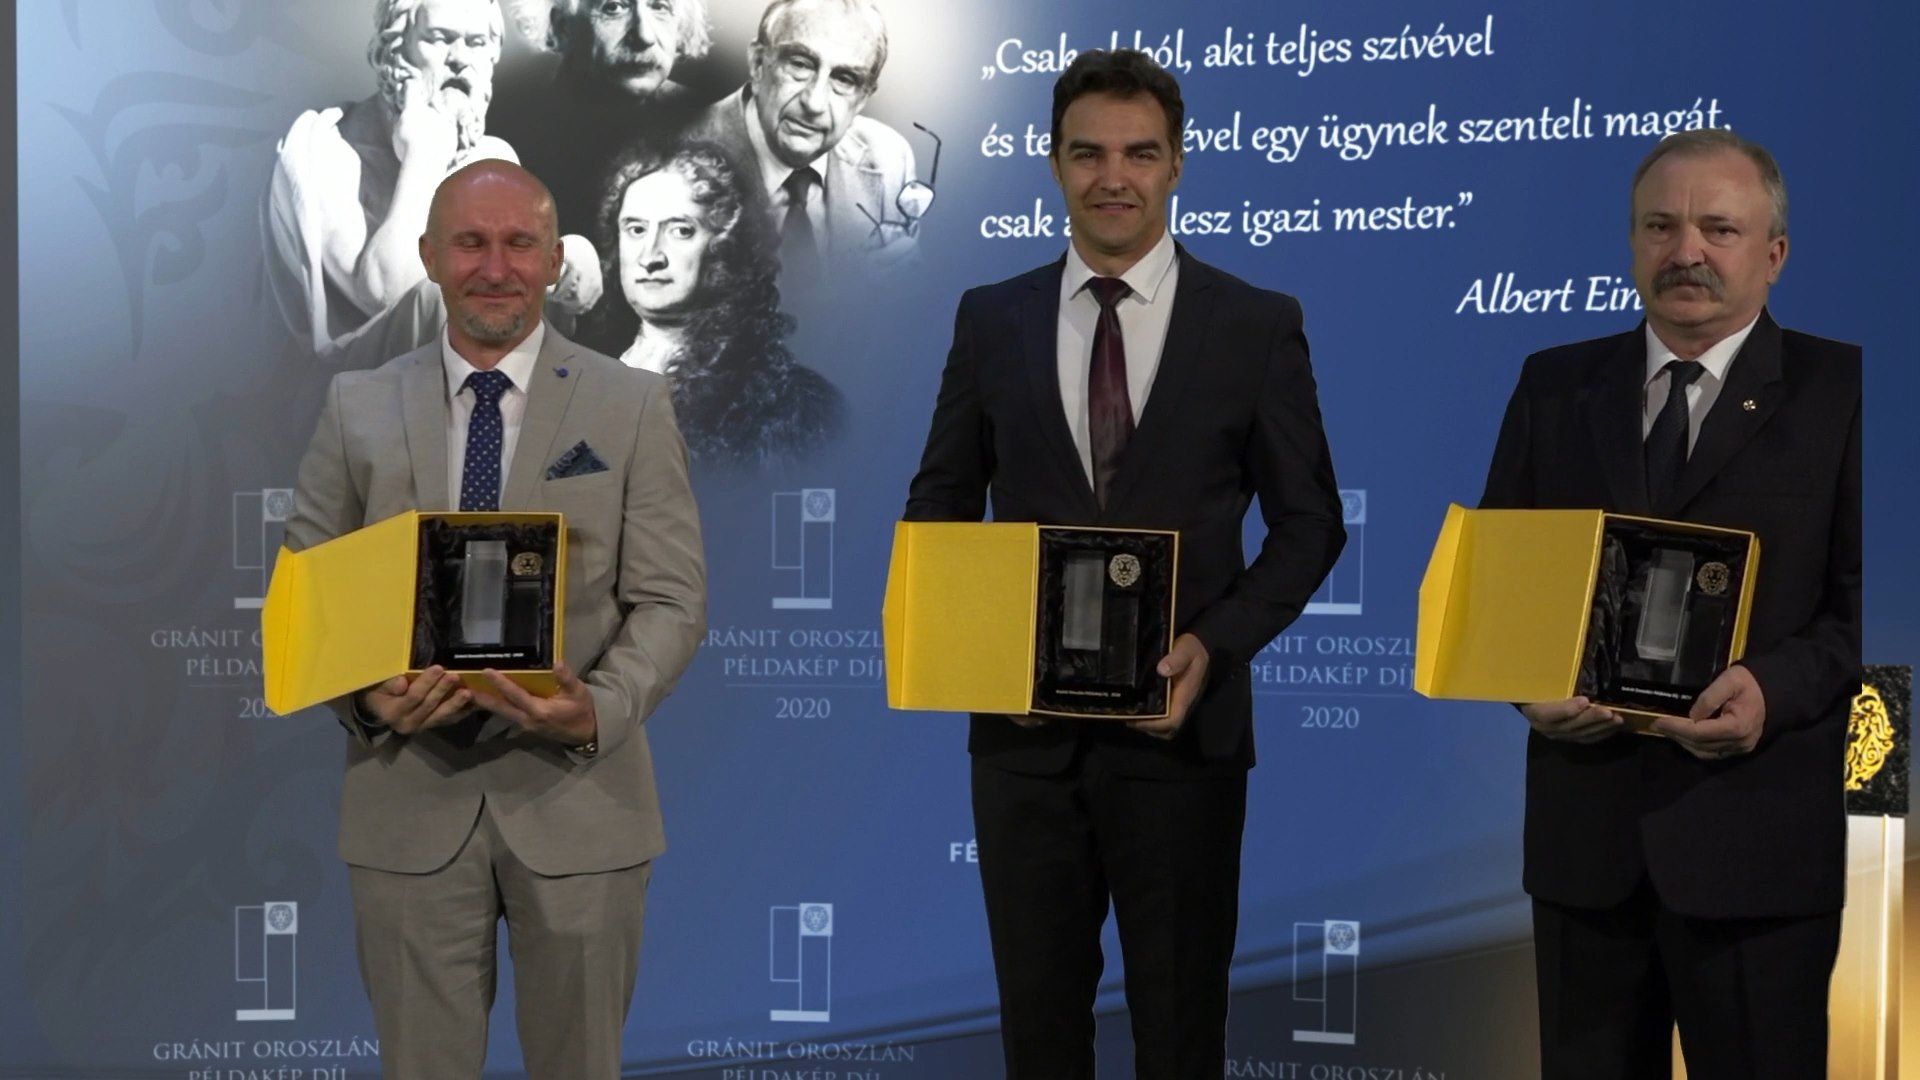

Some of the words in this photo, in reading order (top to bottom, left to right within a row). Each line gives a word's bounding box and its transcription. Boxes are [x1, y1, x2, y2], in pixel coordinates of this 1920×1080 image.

[1203, 26, 1256, 67] aki
[1266, 23, 1352, 77] teljes
[1362, 14, 1495, 61] szívével
[981, 123, 1014, 157] és
[1252, 125, 1310, 163] egy
[1318, 103, 1449, 161] ügynek
[1458, 97, 1594, 143] szenteli
[1603, 97, 1732, 142] magát,
[980, 198, 1054, 238] csak
[1170, 195, 1232, 235] lesz
[1242, 198, 1322, 247] igazi
[1455, 272, 1575, 314] Albert
[1585, 276, 1643, 312] Ein
[151, 625, 244, 648] GRÁNIT
[701, 626, 782, 648] RÁNIT
[789, 629, 883, 648] OROSZL
[1261, 635, 1307, 655] NIT
[1316, 636, 1416, 657] OROSZL
[186, 654, 264, 676] PÉLDA
[724, 654, 839, 677] PÉLDAKÉP
[849, 656, 883, 681] DÍJ
[239, 696, 290, 719] 20
[776, 697, 831, 719] 2020
[1301, 706, 1359, 729] 2020
[153, 1038, 245, 1060] GRÁNIT
[253, 1035, 379, 1058] OROSZLÁN
[687, 1037, 780, 1059] GRÁNIT
[787, 1040, 914, 1062] OROSZLÁN
[1226, 1056, 1301, 1080] RÁNIT
